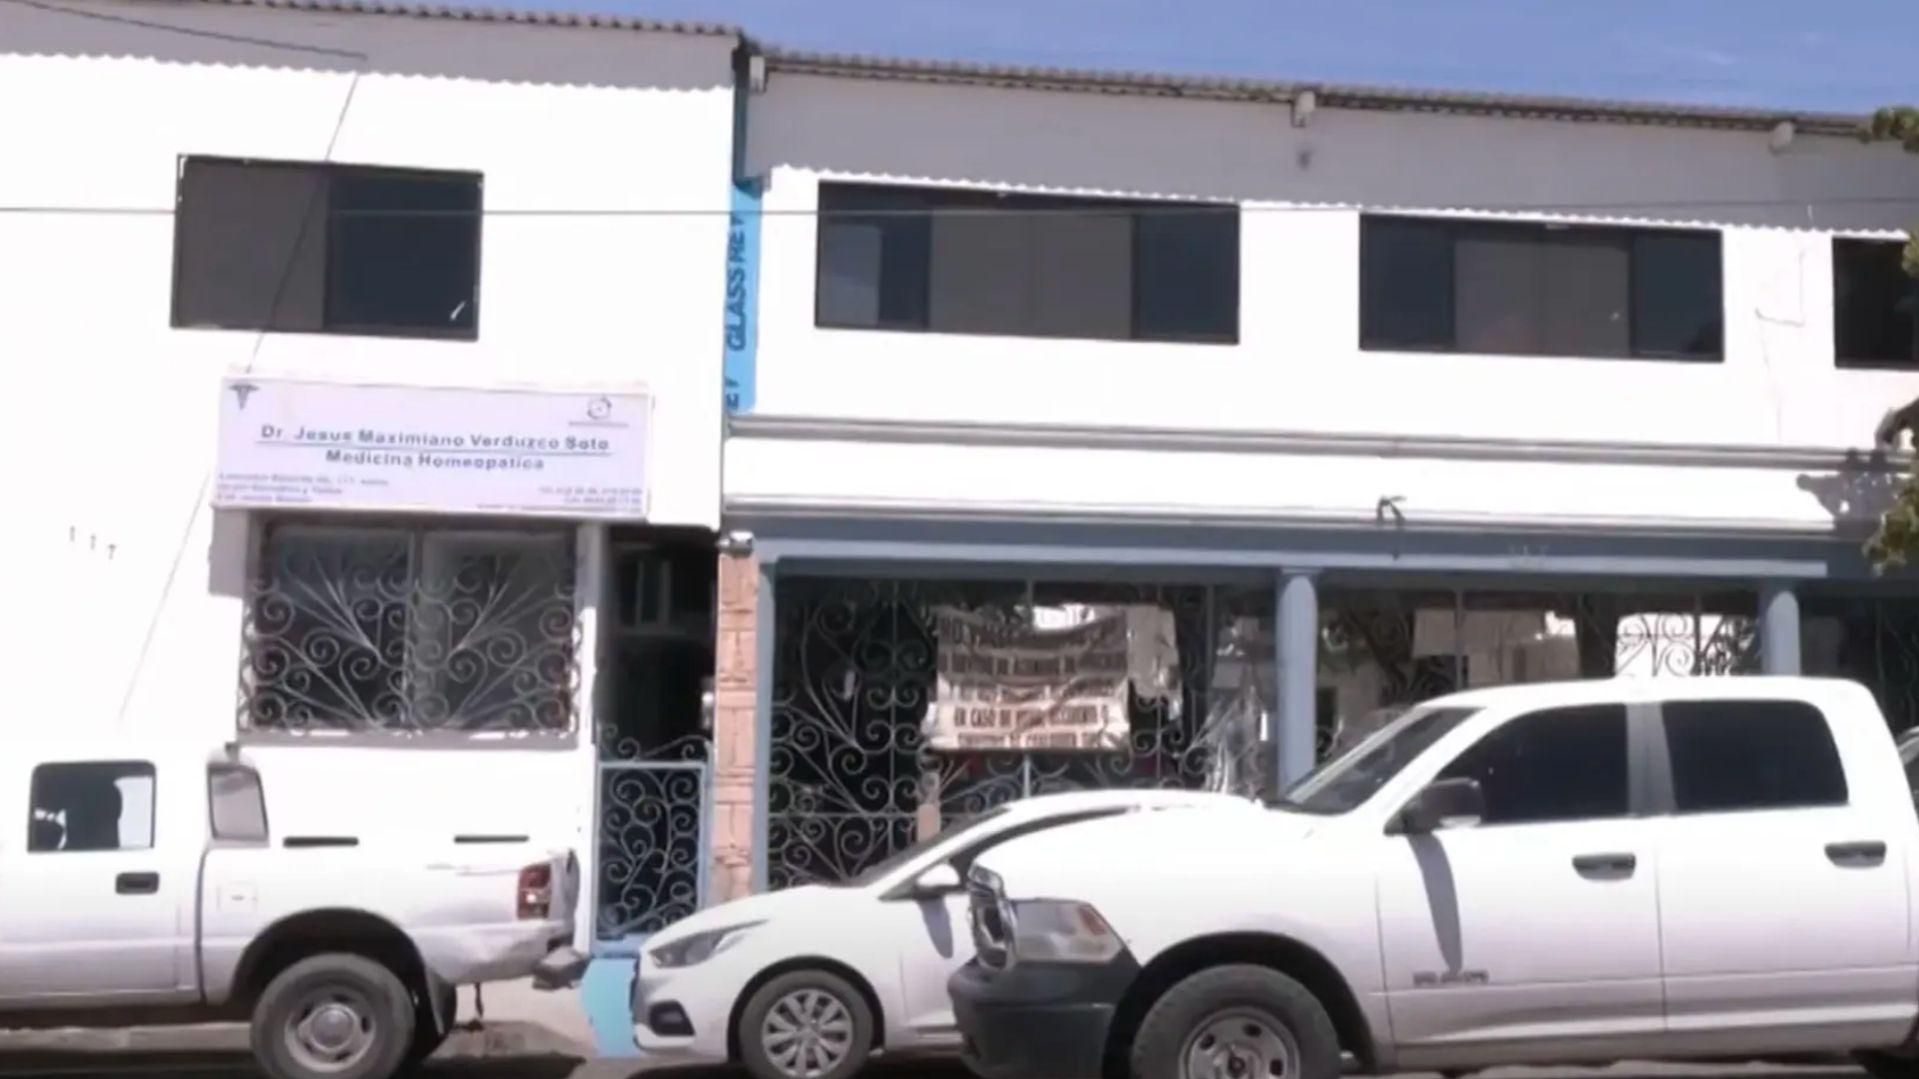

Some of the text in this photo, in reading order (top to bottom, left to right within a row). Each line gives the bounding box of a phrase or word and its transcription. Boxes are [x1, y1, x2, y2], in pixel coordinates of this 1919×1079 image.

[358, 429, 464, 447] Maximiano
[470, 434, 559, 449] Verduzco
[565, 437, 609, 450] Soto
[325, 449, 413, 467] Medicina
